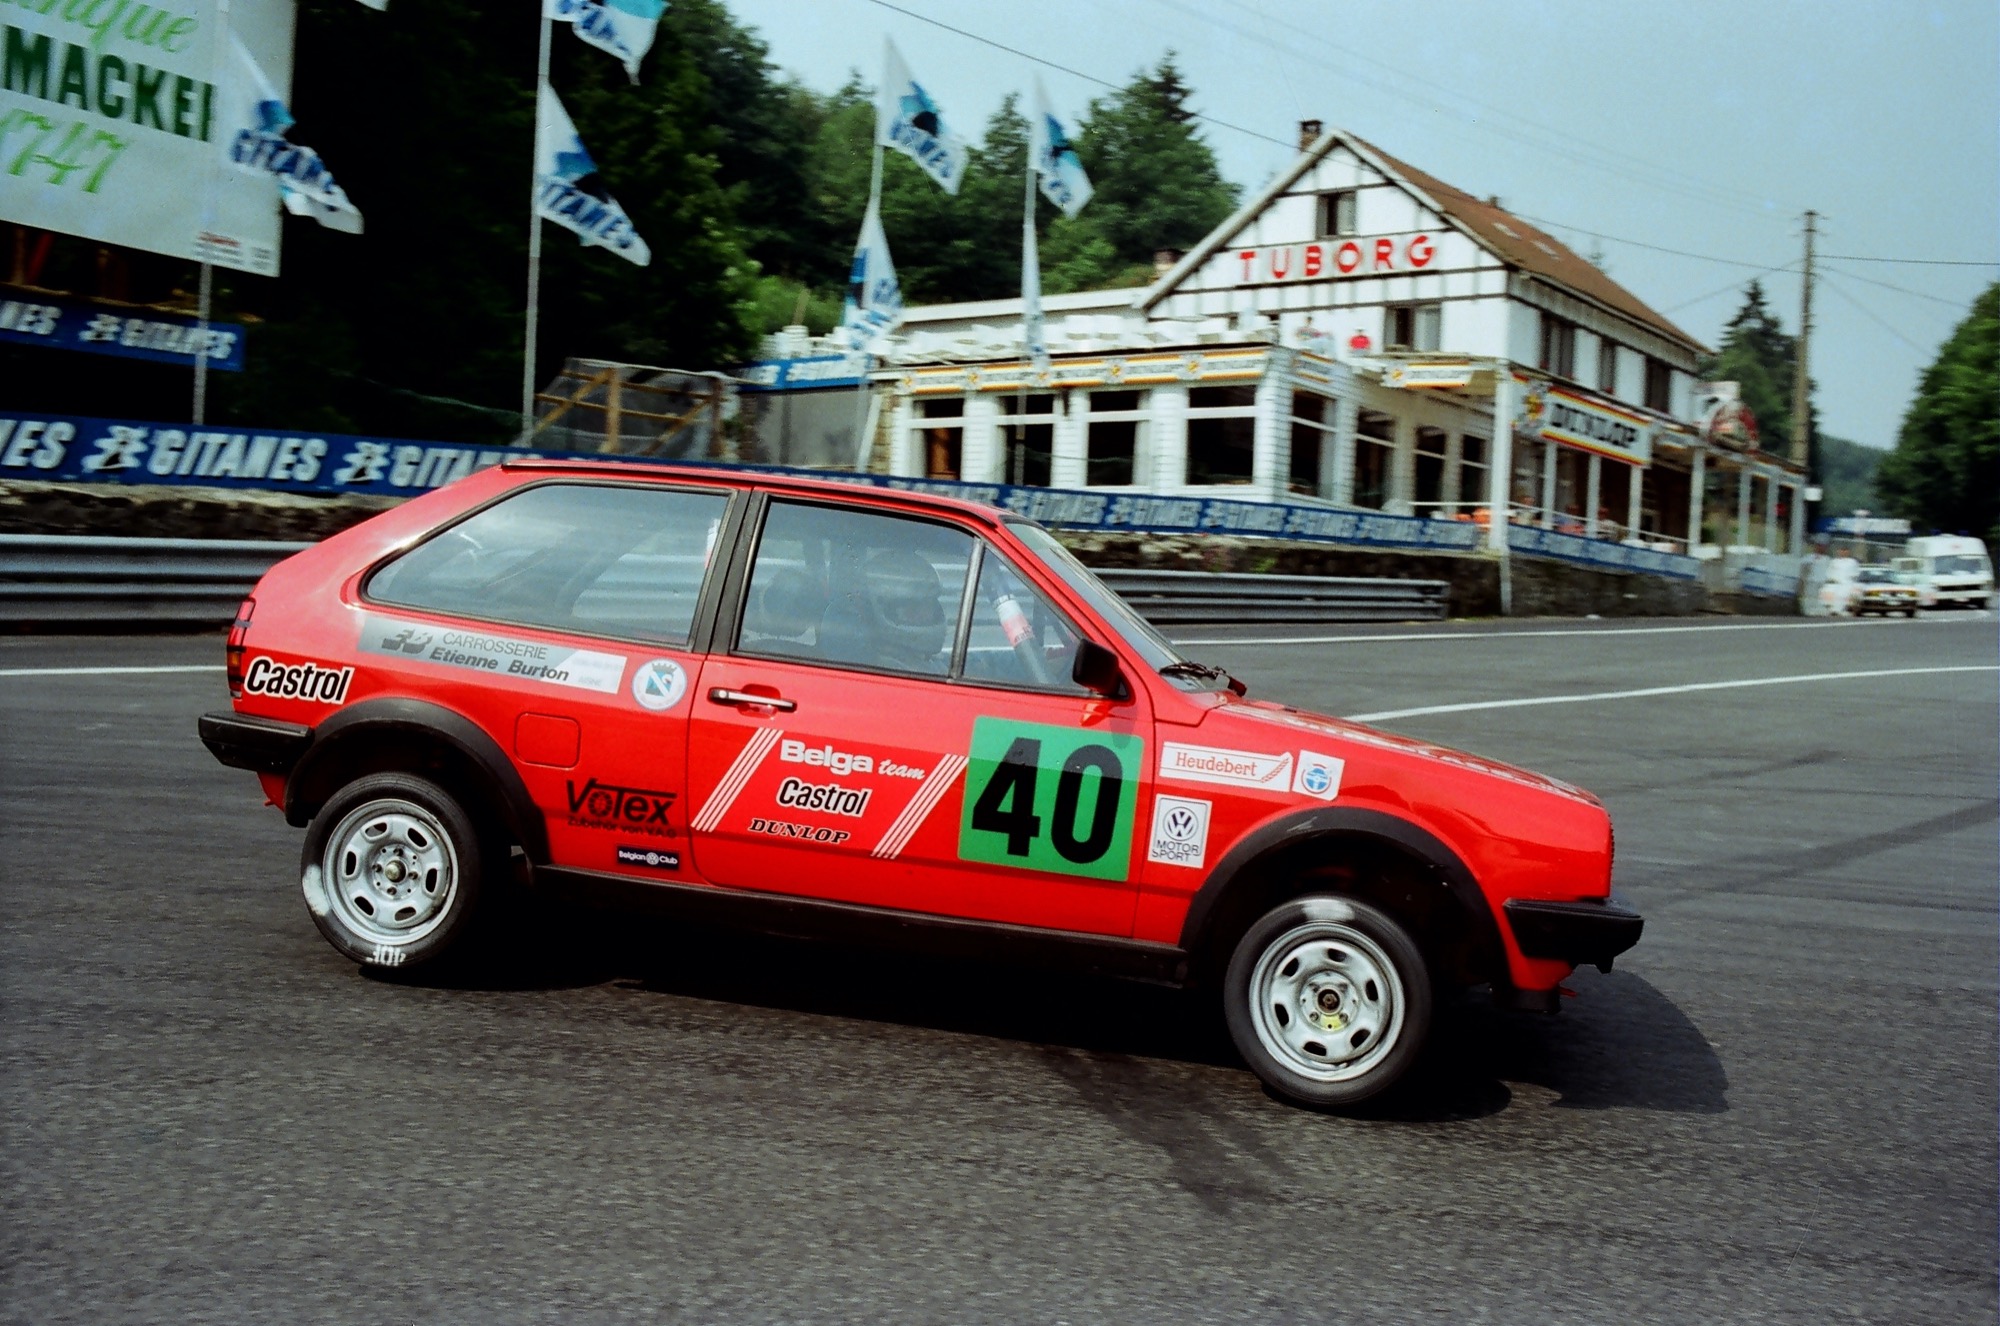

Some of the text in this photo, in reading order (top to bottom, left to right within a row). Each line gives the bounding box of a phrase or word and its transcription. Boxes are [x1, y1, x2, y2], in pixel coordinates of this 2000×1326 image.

[1239, 235, 1434, 282] TUBORG
[147, 428, 327, 482] GITANES
[442, 632, 548, 660] CARROSSERIE
[246, 658, 351, 701] Castrol
[429, 647, 498, 671] Etienne
[508, 659, 569, 682] Burton
[780, 739, 925, 780] Belga team
[1176, 751, 1257, 776] Heudebert
[779, 779, 868, 815] Castrol
[972, 737, 1123, 864] 40
[750, 819, 849, 844] DUNLOP
[1156, 840, 1199, 854] MOTOR
[618, 850, 646, 861] Belgian
[659, 855, 678, 864] Club
[1152, 850, 1191, 862] SPORT
